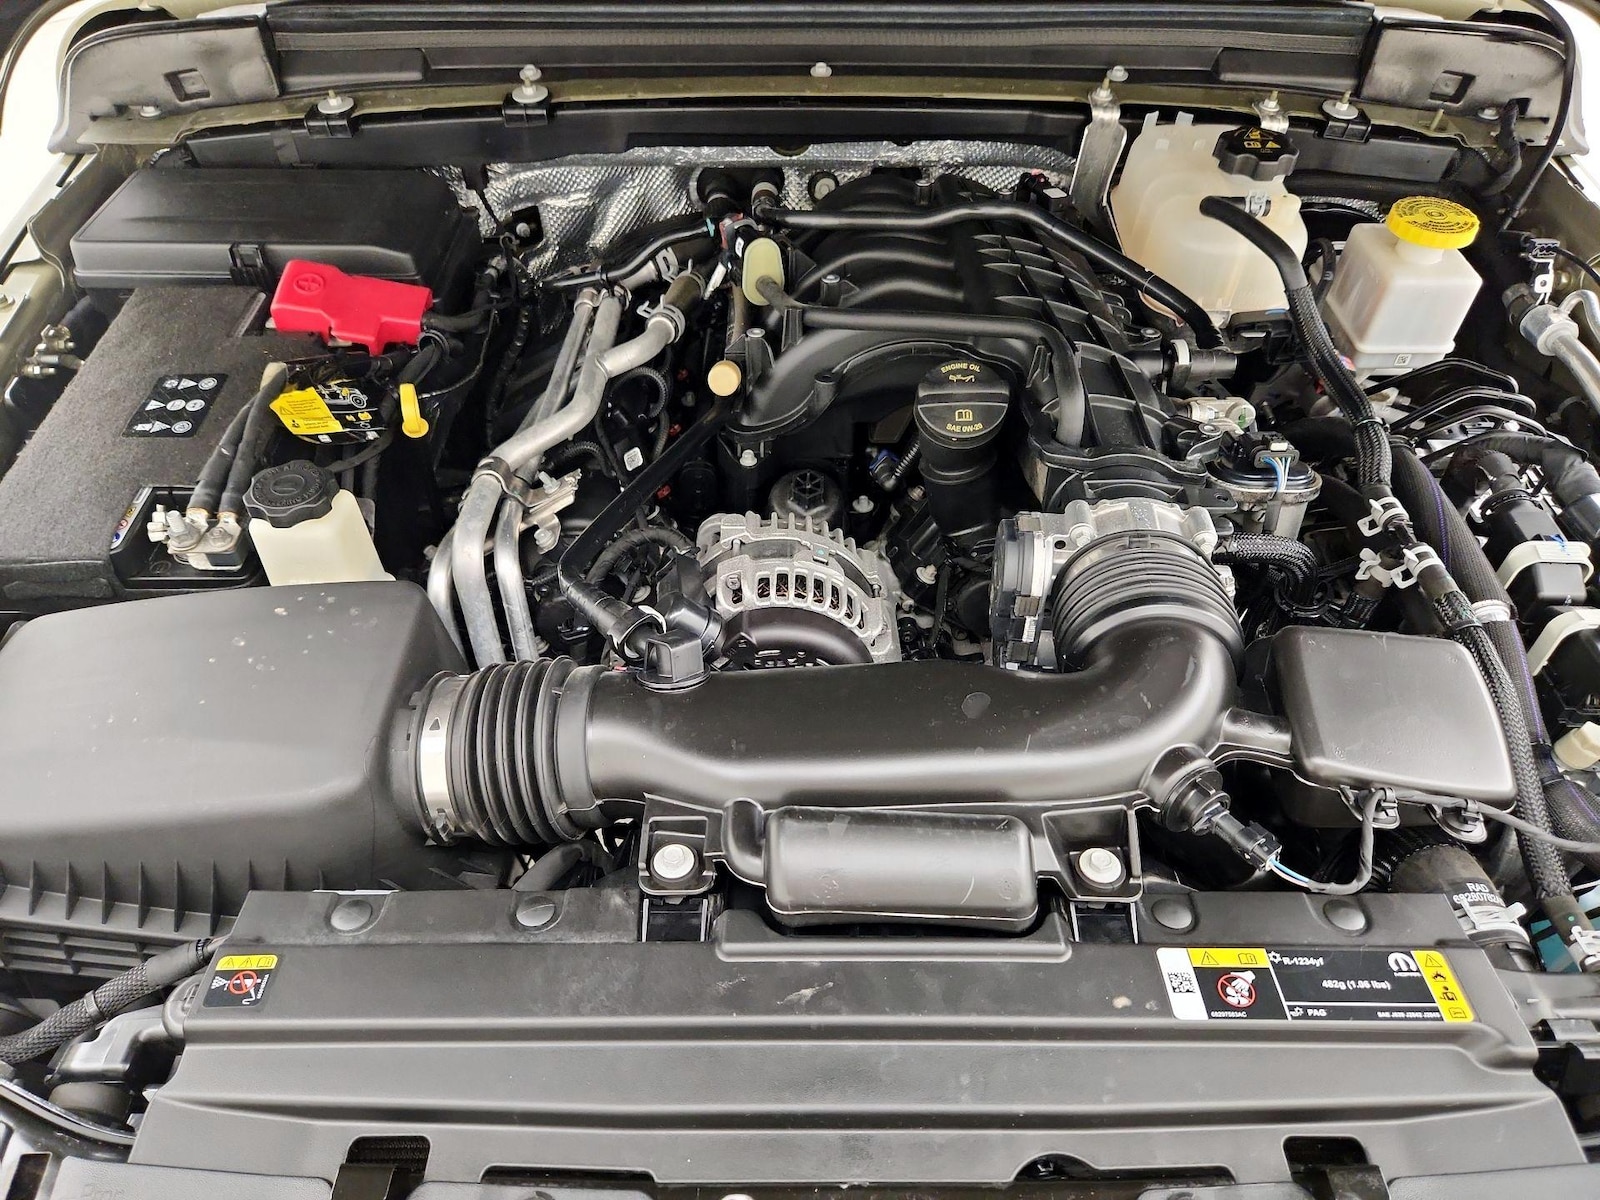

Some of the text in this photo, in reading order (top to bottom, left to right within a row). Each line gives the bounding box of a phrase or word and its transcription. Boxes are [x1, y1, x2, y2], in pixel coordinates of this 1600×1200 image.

[940, 362, 981, 374] ENGINE OIL
[946, 423, 961, 433] SAE
[1466, 882, 1489, 893] RAD
[1282, 956, 1325, 968] R-1234yf
[1371, 980, 1392, 991] lbs)
[1307, 1008, 1328, 1017] PAG
